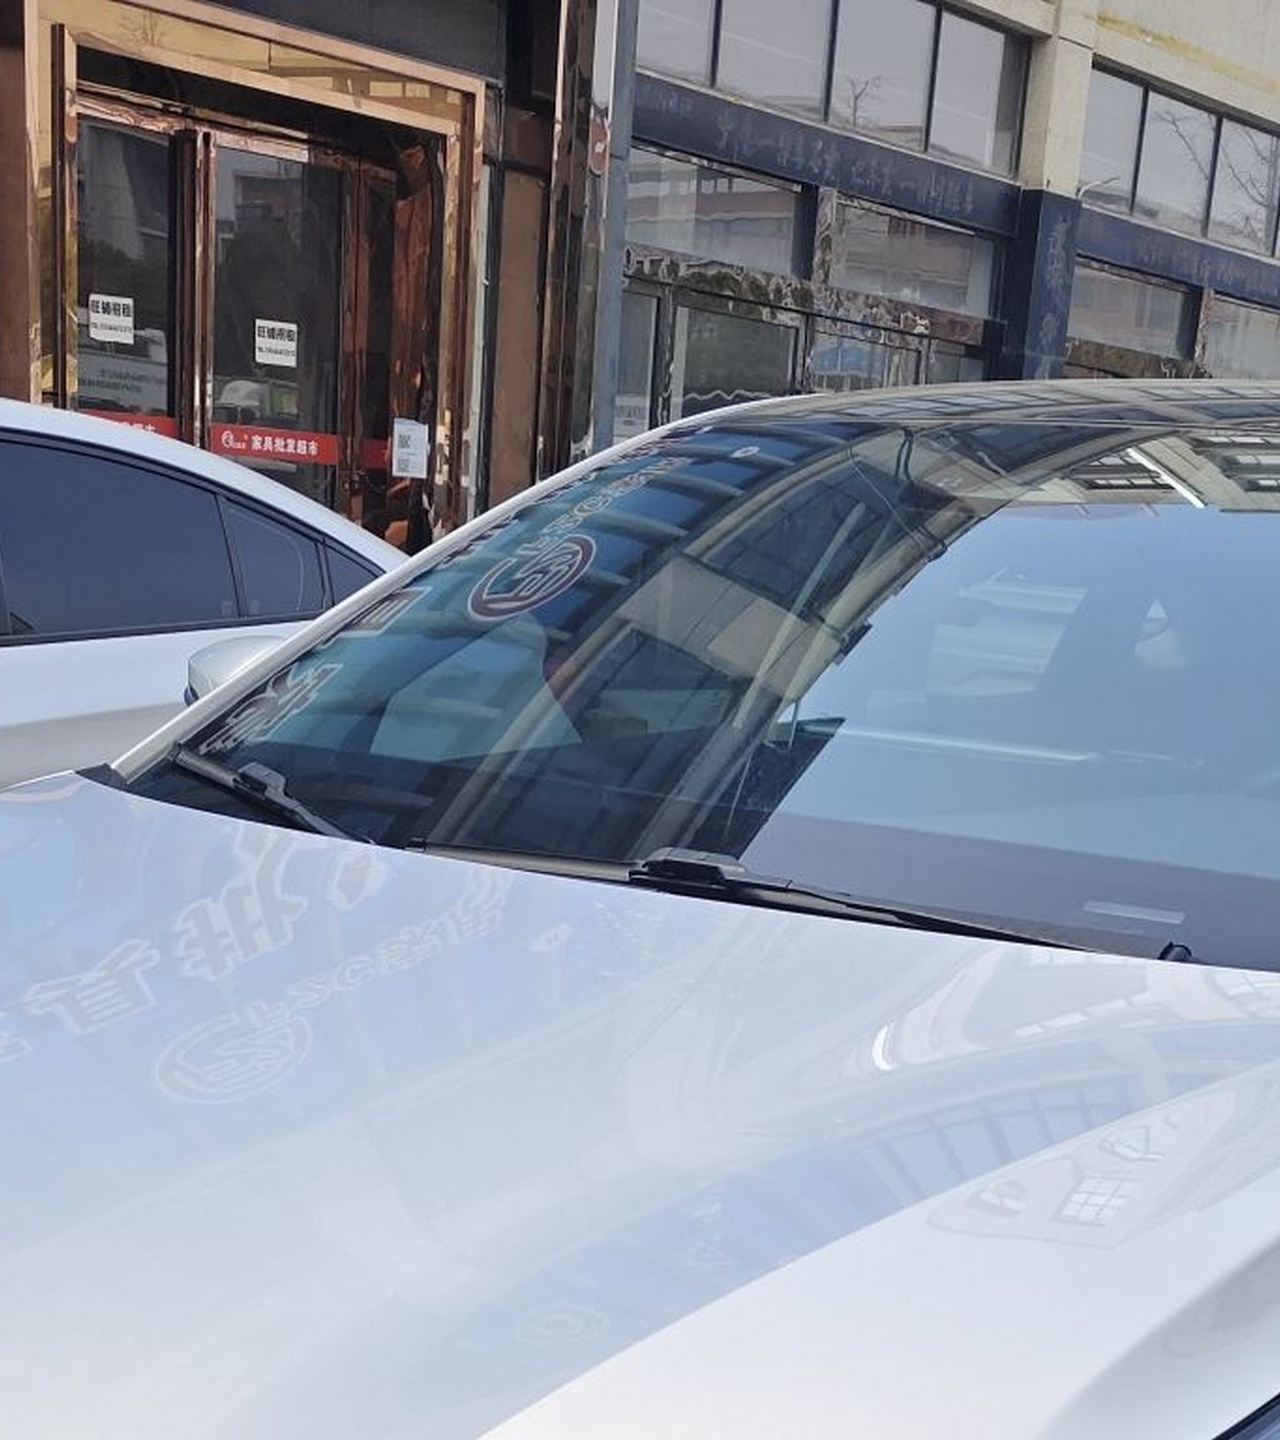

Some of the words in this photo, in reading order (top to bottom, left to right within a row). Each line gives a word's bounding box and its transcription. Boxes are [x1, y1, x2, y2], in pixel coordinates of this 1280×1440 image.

[251, 434, 319, 455] 家具批发超市
